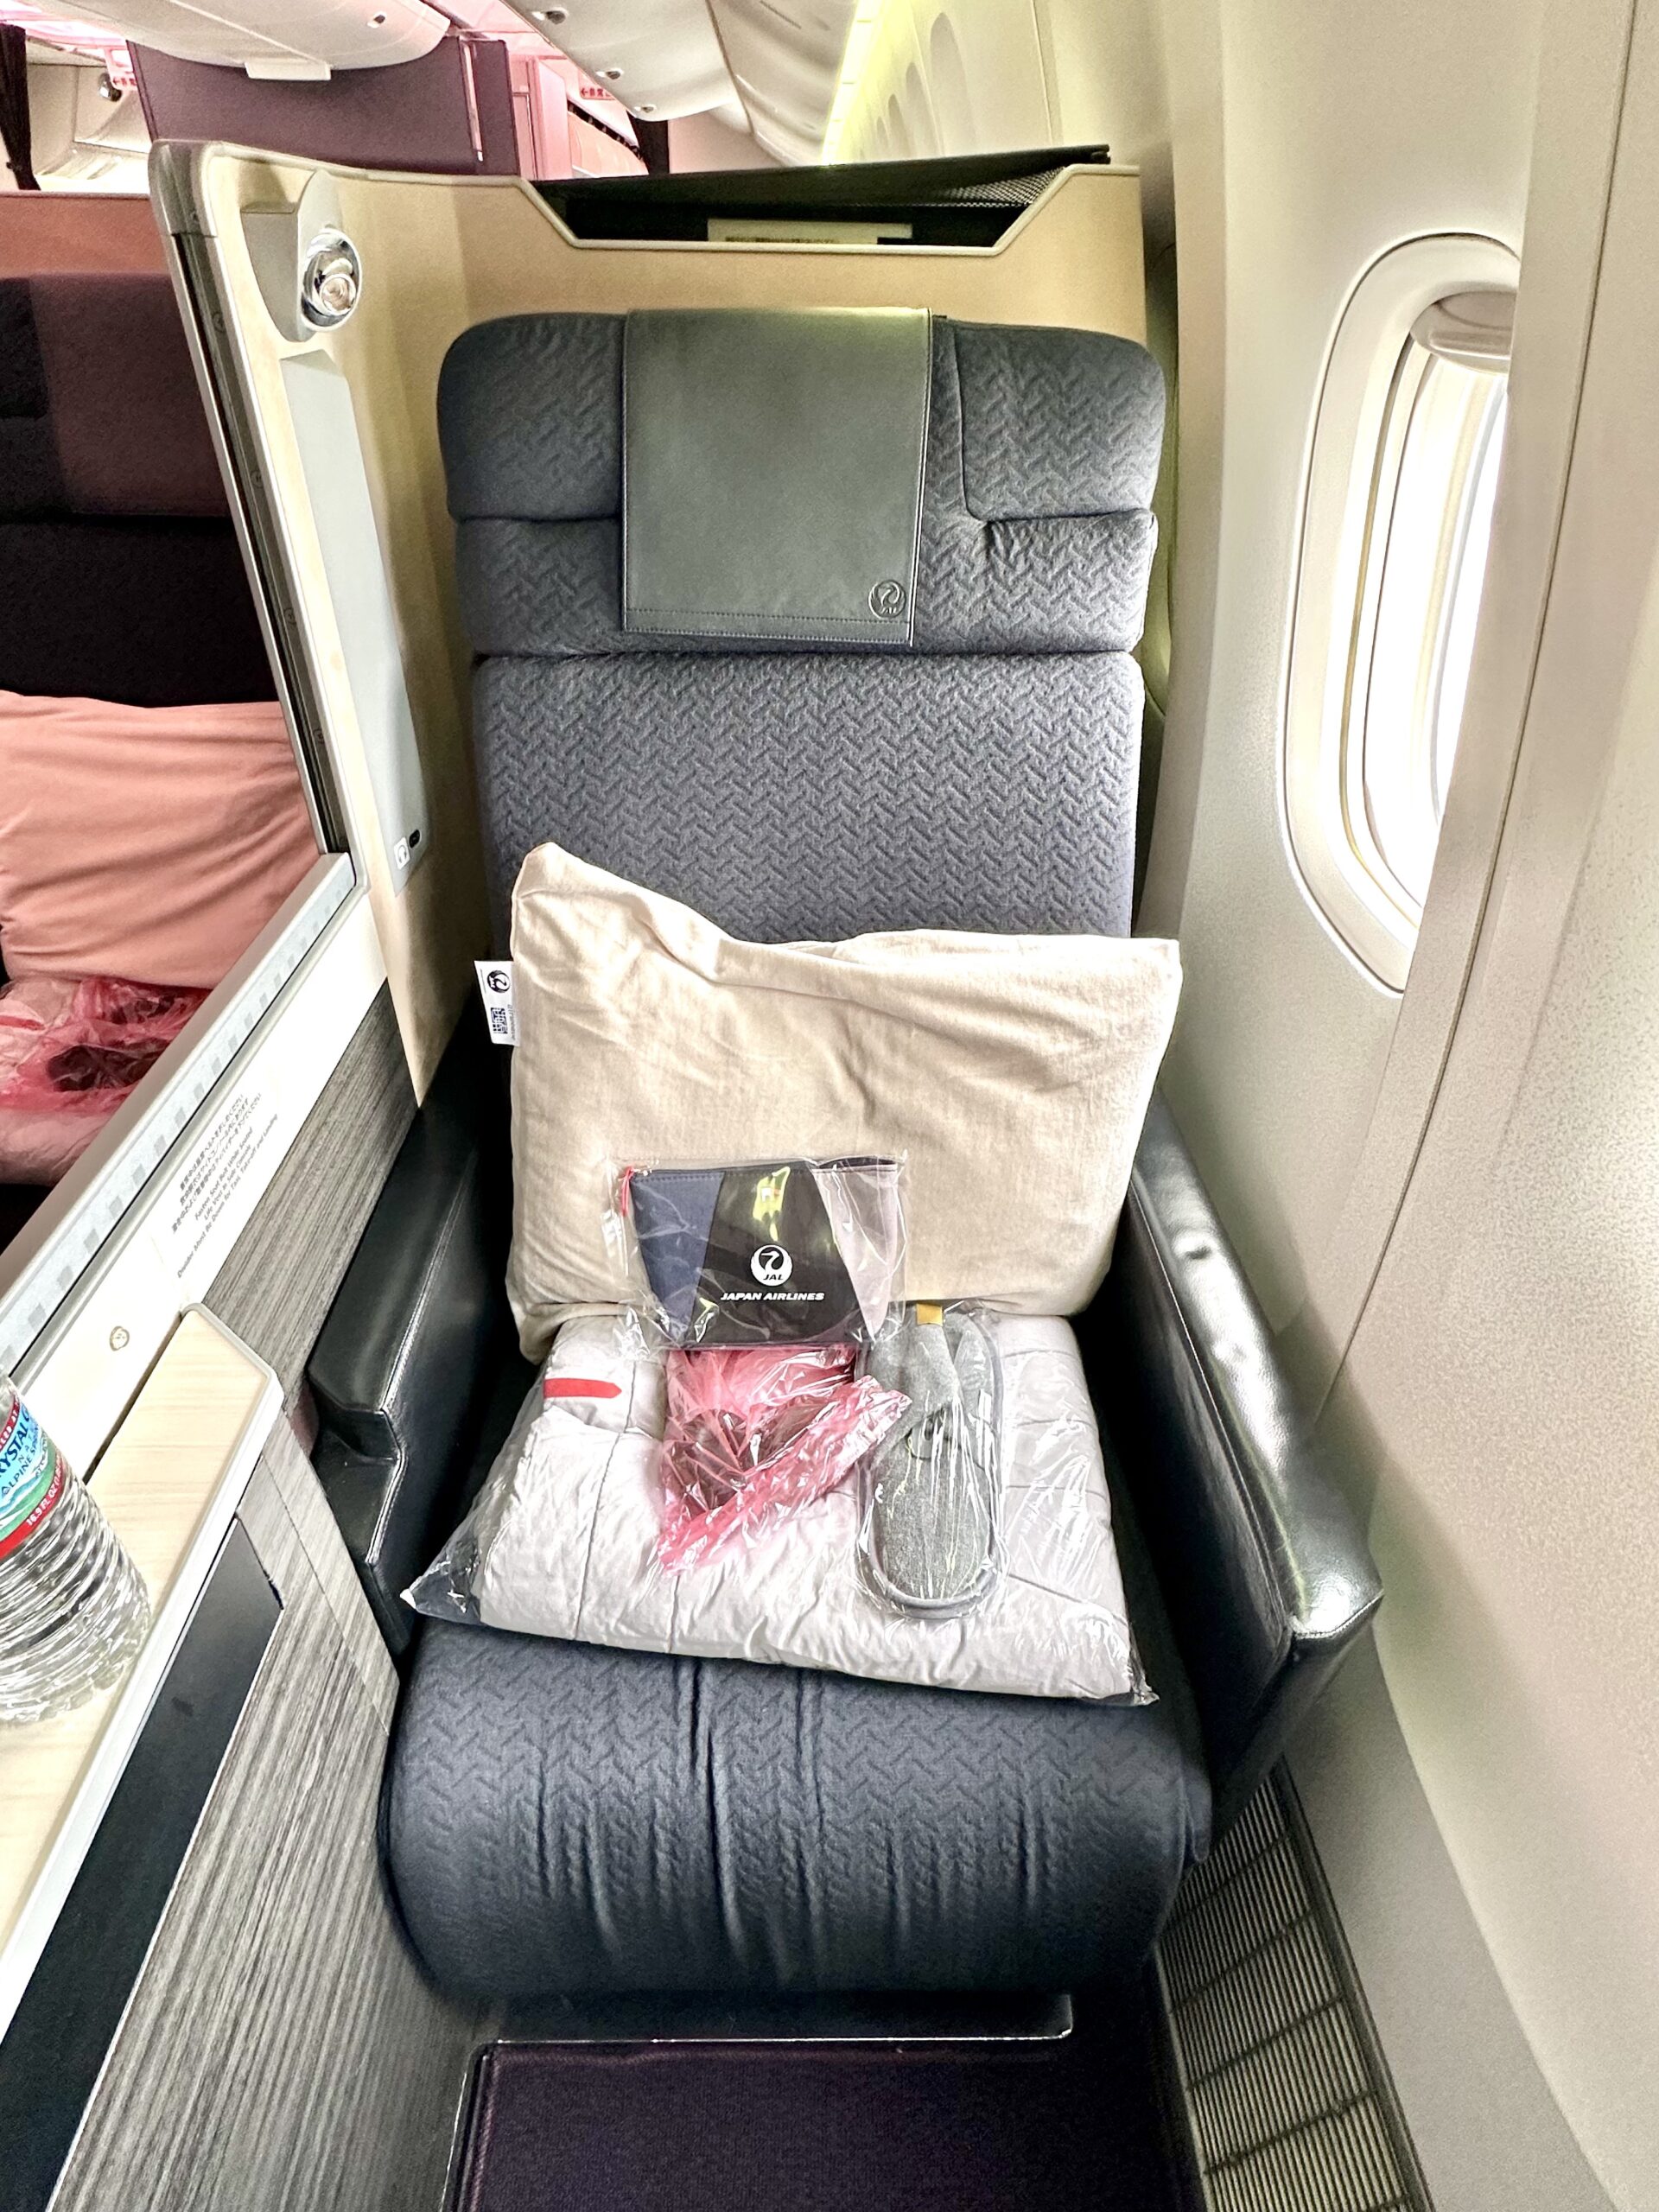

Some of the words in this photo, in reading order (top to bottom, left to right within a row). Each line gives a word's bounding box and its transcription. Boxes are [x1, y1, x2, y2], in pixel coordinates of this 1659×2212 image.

[194, 1197, 211, 1220] Fasten
[209, 1180, 221, 1196] Seat
[219, 1166, 229, 1181] Belt
[227, 1148, 240, 1167] While
[238, 1127, 253, 1150] Seated
[194, 1230, 207, 1252] Must
[212, 1200, 226, 1223] Down
[256, 1135, 264, 1149] and
[263, 1113, 278, 1137] Landing
[203, 1205, 213, 1220] Life
[212, 1190, 223, 1206] Vest
[226, 1168, 237, 1182] Side
[236, 1145, 252, 1169] Console
[721, 1292, 762, 1301] JAPAN
[763, 1292, 825, 1301] AIRLINES
[26, 1507, 43, 1526] 16.9
[41, 1497, 51, 1510] FL
